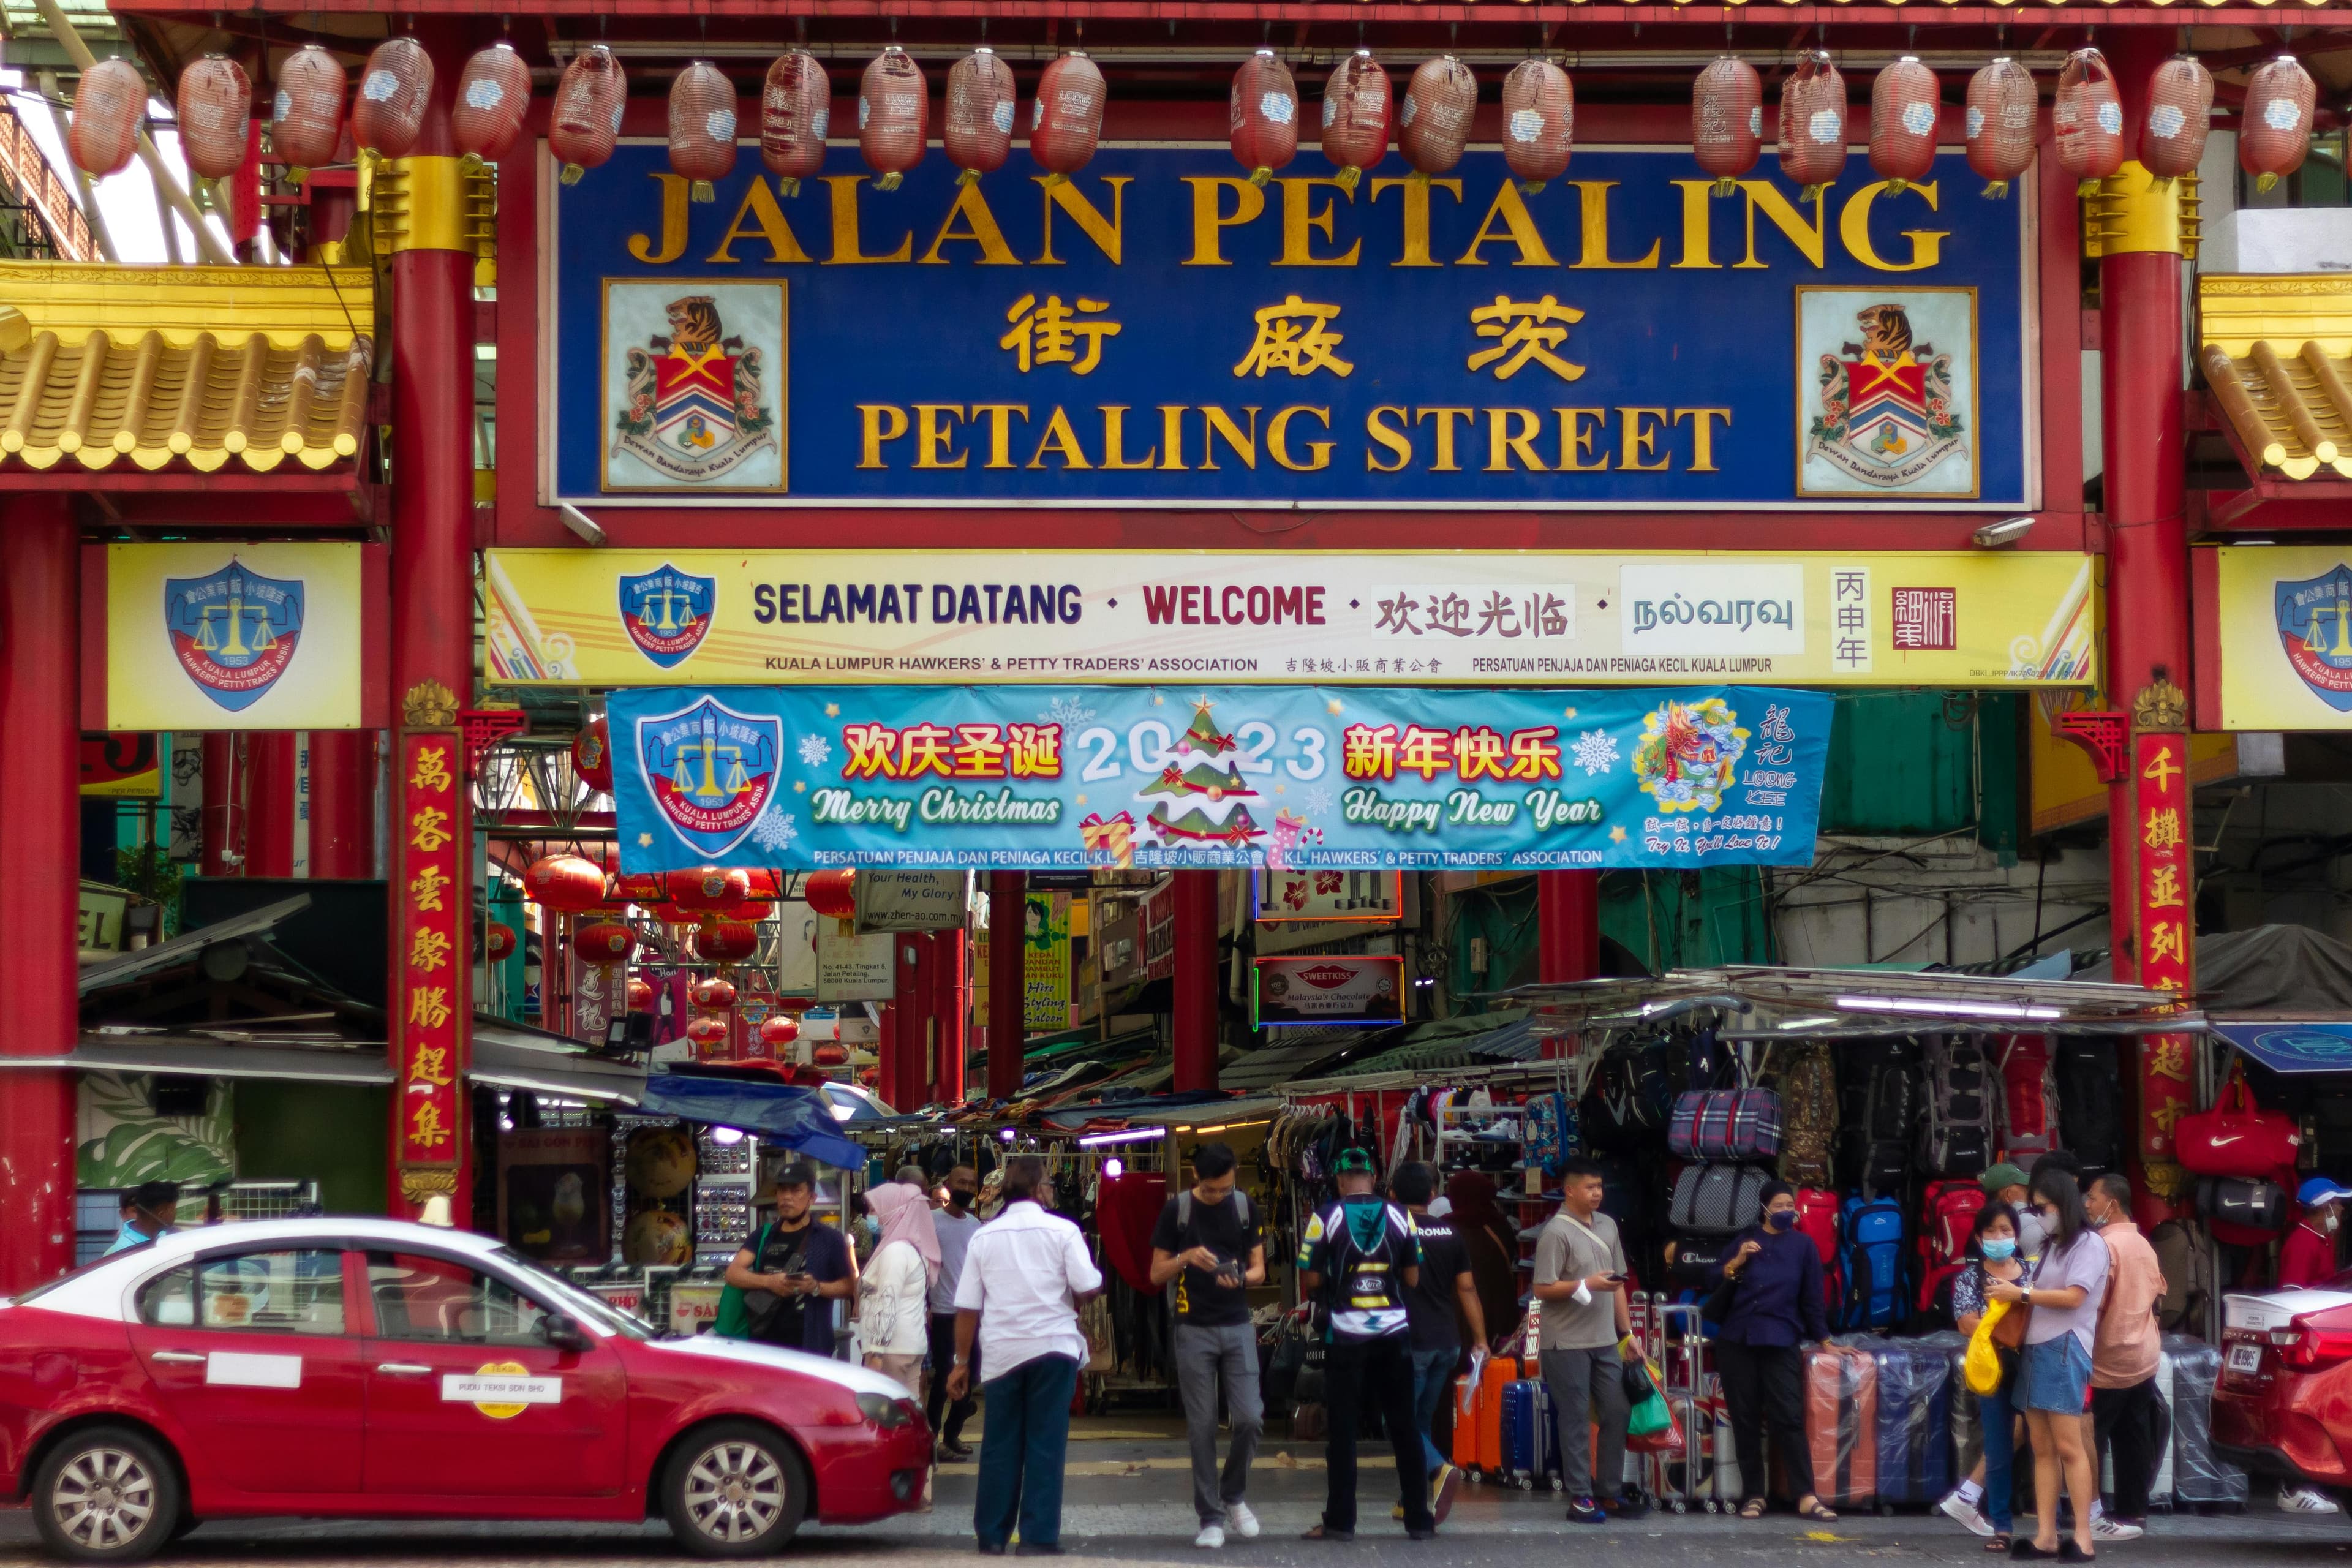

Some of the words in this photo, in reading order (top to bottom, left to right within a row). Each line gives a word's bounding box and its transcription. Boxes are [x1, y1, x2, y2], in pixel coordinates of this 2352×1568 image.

[627, 173, 1135, 266] JALAN
[1180, 176, 1951, 273] PETALING
[855, 404, 1338, 472] PETALING
[1366, 405, 1732, 473] STREET
[624, 435, 655, 459] Dewan
[655, 454, 707, 478] Bandaraya
[708, 454, 733, 473] Kuala
[733, 431, 768, 460] Lumpur
[1817, 440, 1850, 465] Dewan
[1850, 460, 1899, 483] Bandaraya
[1901, 462, 1927, 481] Kuala
[1926, 437, 1959, 466] Lumpur
[754, 583, 923, 624] SELAMAT
[932, 584, 1082, 625] DATANG
[1142, 585, 1327, 626] WELCOME
[1633, 592, 1793, 635] நல்வரவு
[1374, 590, 1569, 638] 欢迎光临
[1834, 571, 1868, 668] 丙申年
[645, 633, 666, 646] KUALA
[667, 633, 693, 646] LUMPUR
[202, 660, 232, 679] KUALA
[235, 660, 271, 679] LUMPUR
[218, 679, 244, 688] PETTY
[275, 641, 291, 666] ASSN.
[223, 657, 249, 666] 1953
[766, 657, 821, 670] KUALA
[827, 657, 895, 670] LUMPUR
[990, 658, 1001, 671] &
[1007, 658, 1058, 671] PETTY
[1148, 658, 1257, 671] ASSOCIATION
[1472, 658, 1534, 673] PERSATUAN
[1537, 658, 1583, 673] PENJAJA
[1586, 658, 1608, 673] DAN
[1610, 658, 1657, 673] PENIAGA
[1659, 658, 1689, 673] KECIL
[1692, 658, 1726, 673] KUALA
[1728, 658, 1772, 673] LUMPUR
[2312, 660, 2340, 679] KUALA
[2333, 657, 2352, 666] 195
[843, 723, 1061, 778] 欢庆圣诞
[1344, 725, 1562, 781] 新年快乐
[1742, 769, 1798, 789] LOONG
[695, 820, 722, 829] PETTY
[750, 783, 765, 809] ASSN.
[699, 798, 724, 807] 1953
[1745, 790, 1787, 807] KEE
[679, 801, 708, 821] KUALA
[711, 802, 747, 821] LUMPUR
[812, 788, 912, 830] Merry
[920, 788, 1061, 821] Christmas
[1343, 789, 1441, 831] Happy
[1448, 790, 1516, 822] New
[1525, 789, 1602, 828] Year
[1645, 837, 1670, 856] Try
[1674, 837, 1691, 853] It,
[1724, 834, 1752, 850] Love
[813, 850, 894, 864] PERSATUAN
[897, 850, 957, 864] PENJAJA
[958, 850, 990, 864] DAN
[992, 850, 1050, 864] PENIAGA
[1054, 850, 1092, 864] KECIL
[1095, 850, 1118, 864] K.L.
[1134, 849, 1264, 865] 吉隆坡小販商業公會
[1284, 850, 1308, 864] K.L.
[1386, 852, 1396, 864] &
[1399, 851, 1440, 865] PETTY
[1512, 850, 1602, 864] ASSOCIATION
[868, 873, 893, 883] Your
[896, 873, 940, 886] Health,
[901, 889, 919, 900] My
[922, 888, 954, 901] Glory
[867, 910, 964, 925] www.zhen-ao.com.my
[1303, 971, 1352, 981] SWEETKISS
[1027, 981, 1055, 995] Hiro
[1287, 993, 1329, 1002] Malaysia's
[1330, 992, 1371, 1001] Chocolate
[1024, 995, 1066, 1011] Styling
[1024, 1011, 1064, 1025] Saloon
[1417, 1227, 1452, 1236] RONAS
